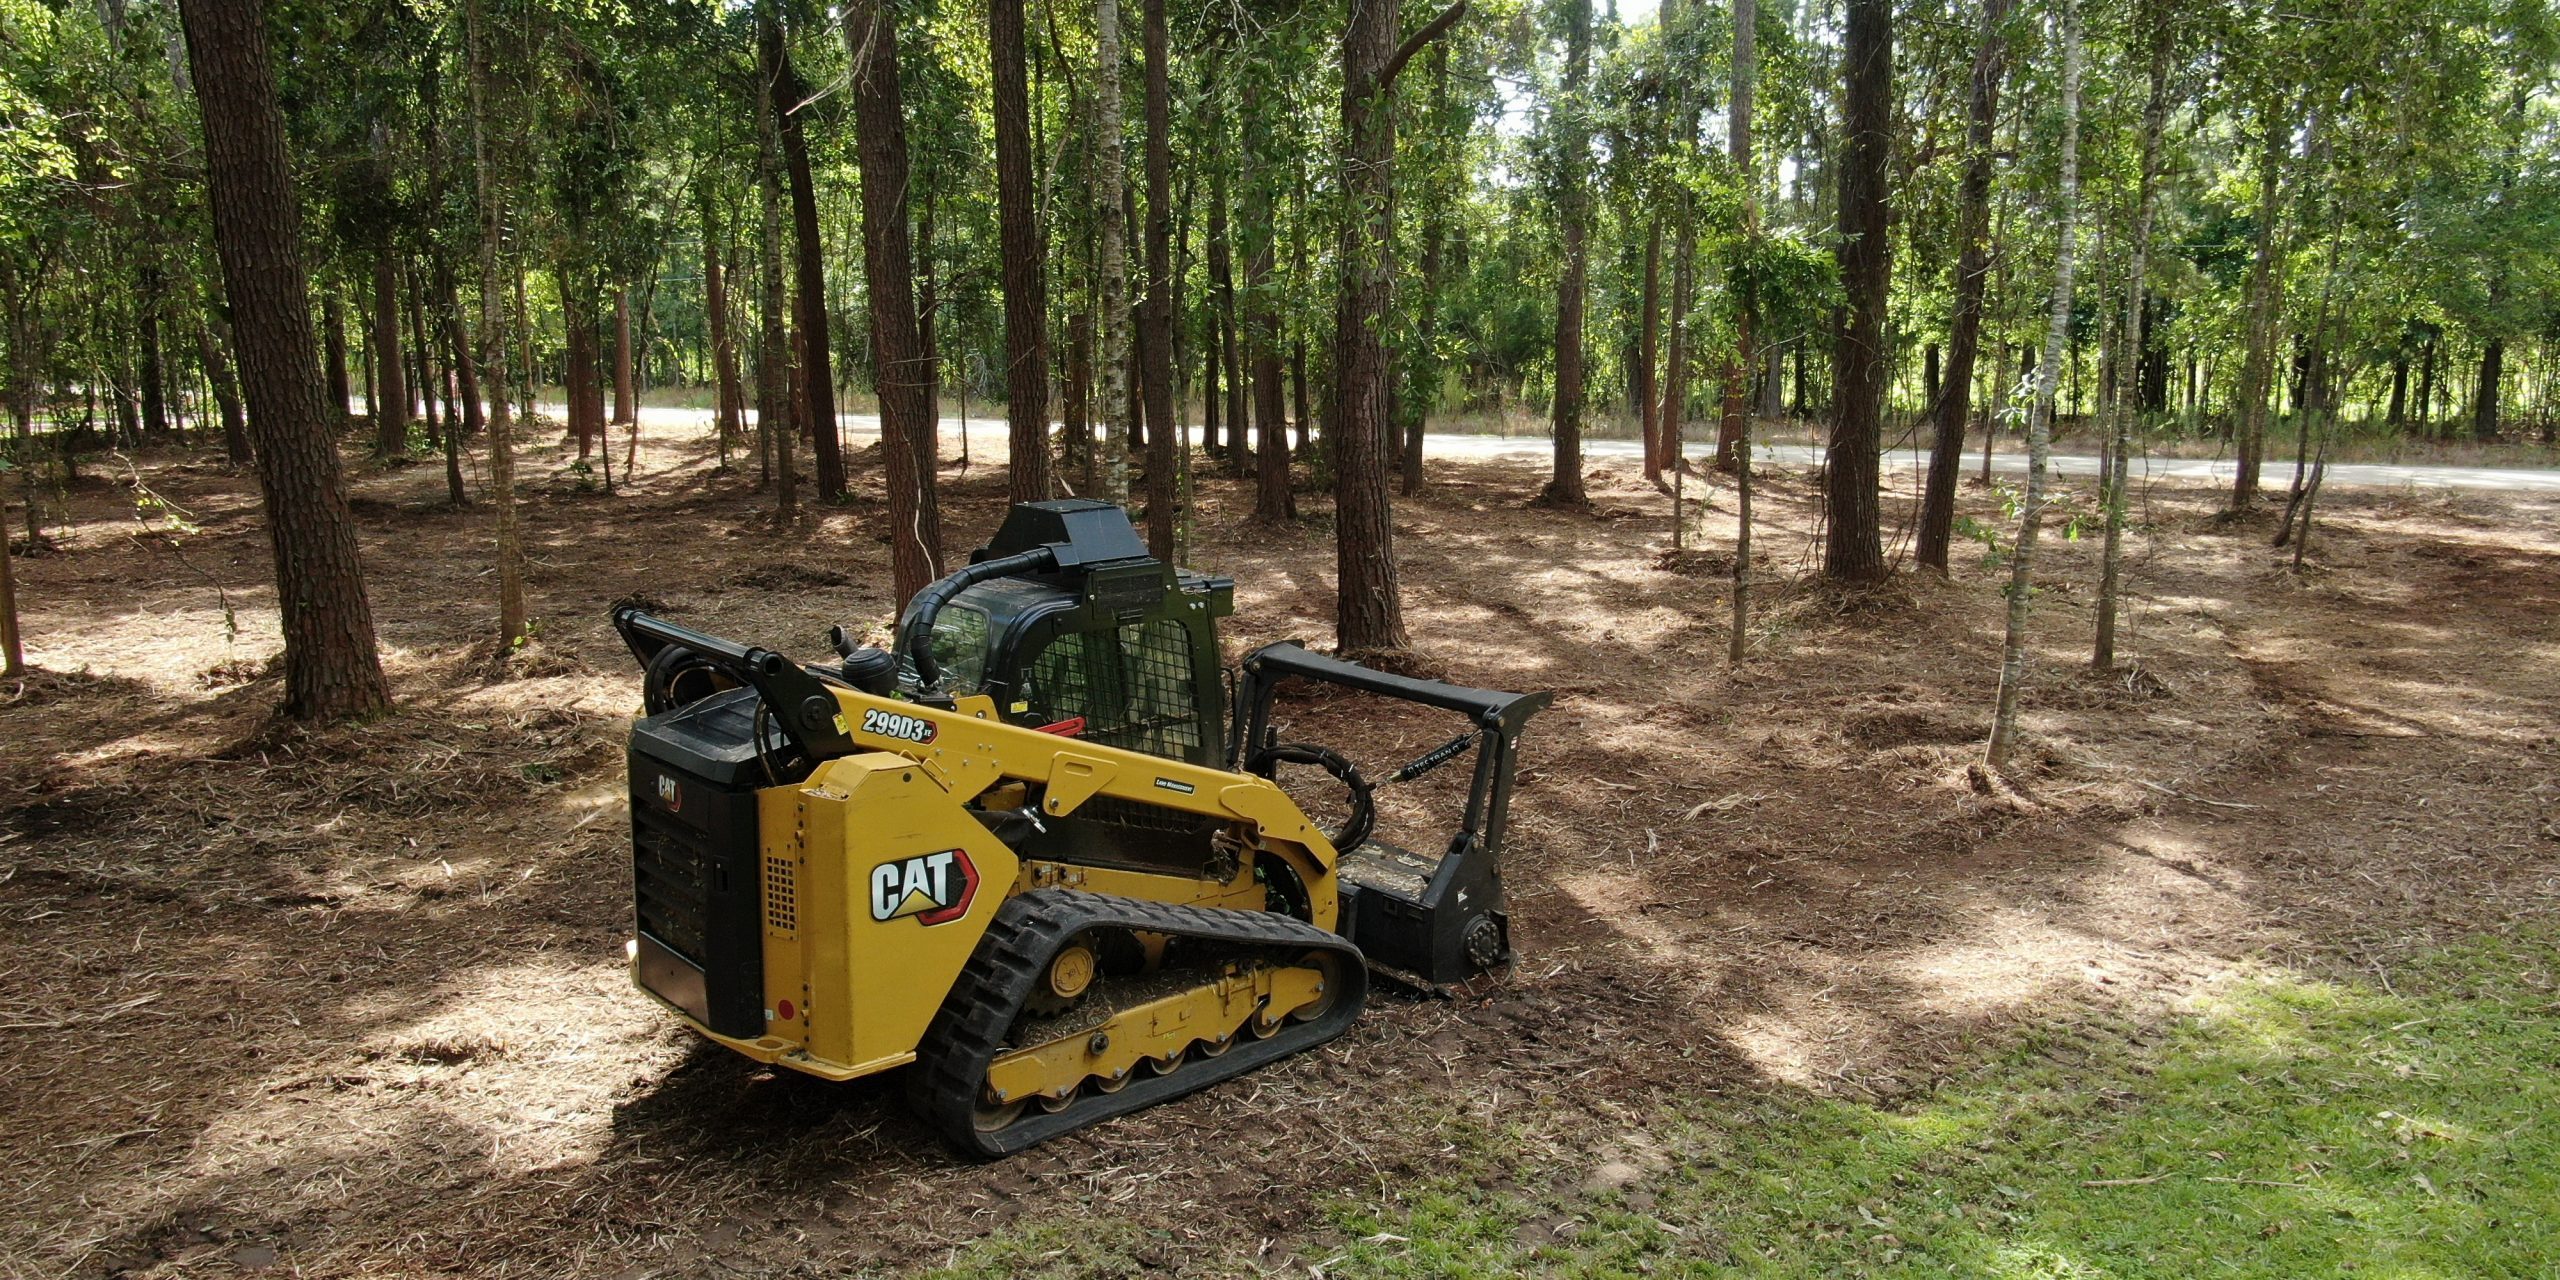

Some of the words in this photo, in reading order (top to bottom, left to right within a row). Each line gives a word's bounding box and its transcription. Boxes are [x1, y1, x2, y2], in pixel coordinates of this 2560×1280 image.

[862, 709, 925, 741] 299D3
[659, 774, 676, 802] CAT
[872, 851, 953, 920] CAT
